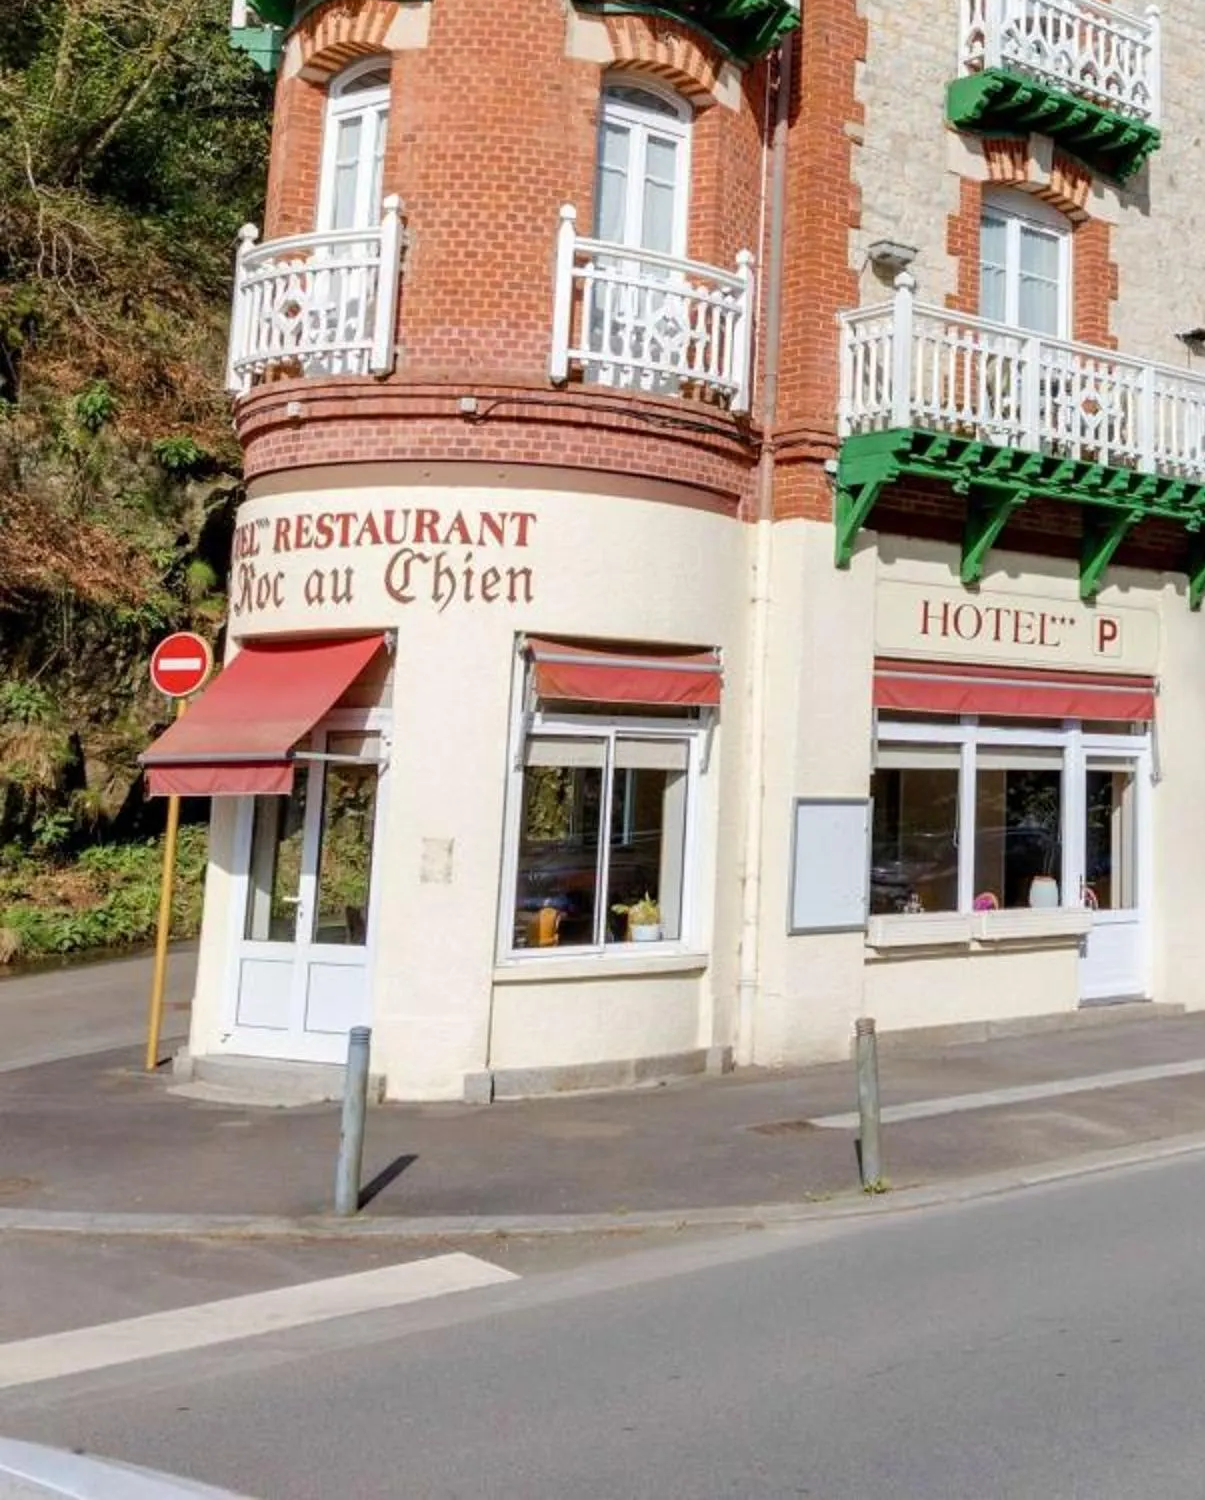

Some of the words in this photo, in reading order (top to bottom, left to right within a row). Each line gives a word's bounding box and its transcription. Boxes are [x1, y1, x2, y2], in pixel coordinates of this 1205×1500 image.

[273, 508, 537, 553] RESTAURANT
[304, 566, 354, 606] au
[384, 547, 534, 613] Chien
[1098, 618, 1118, 652] P
